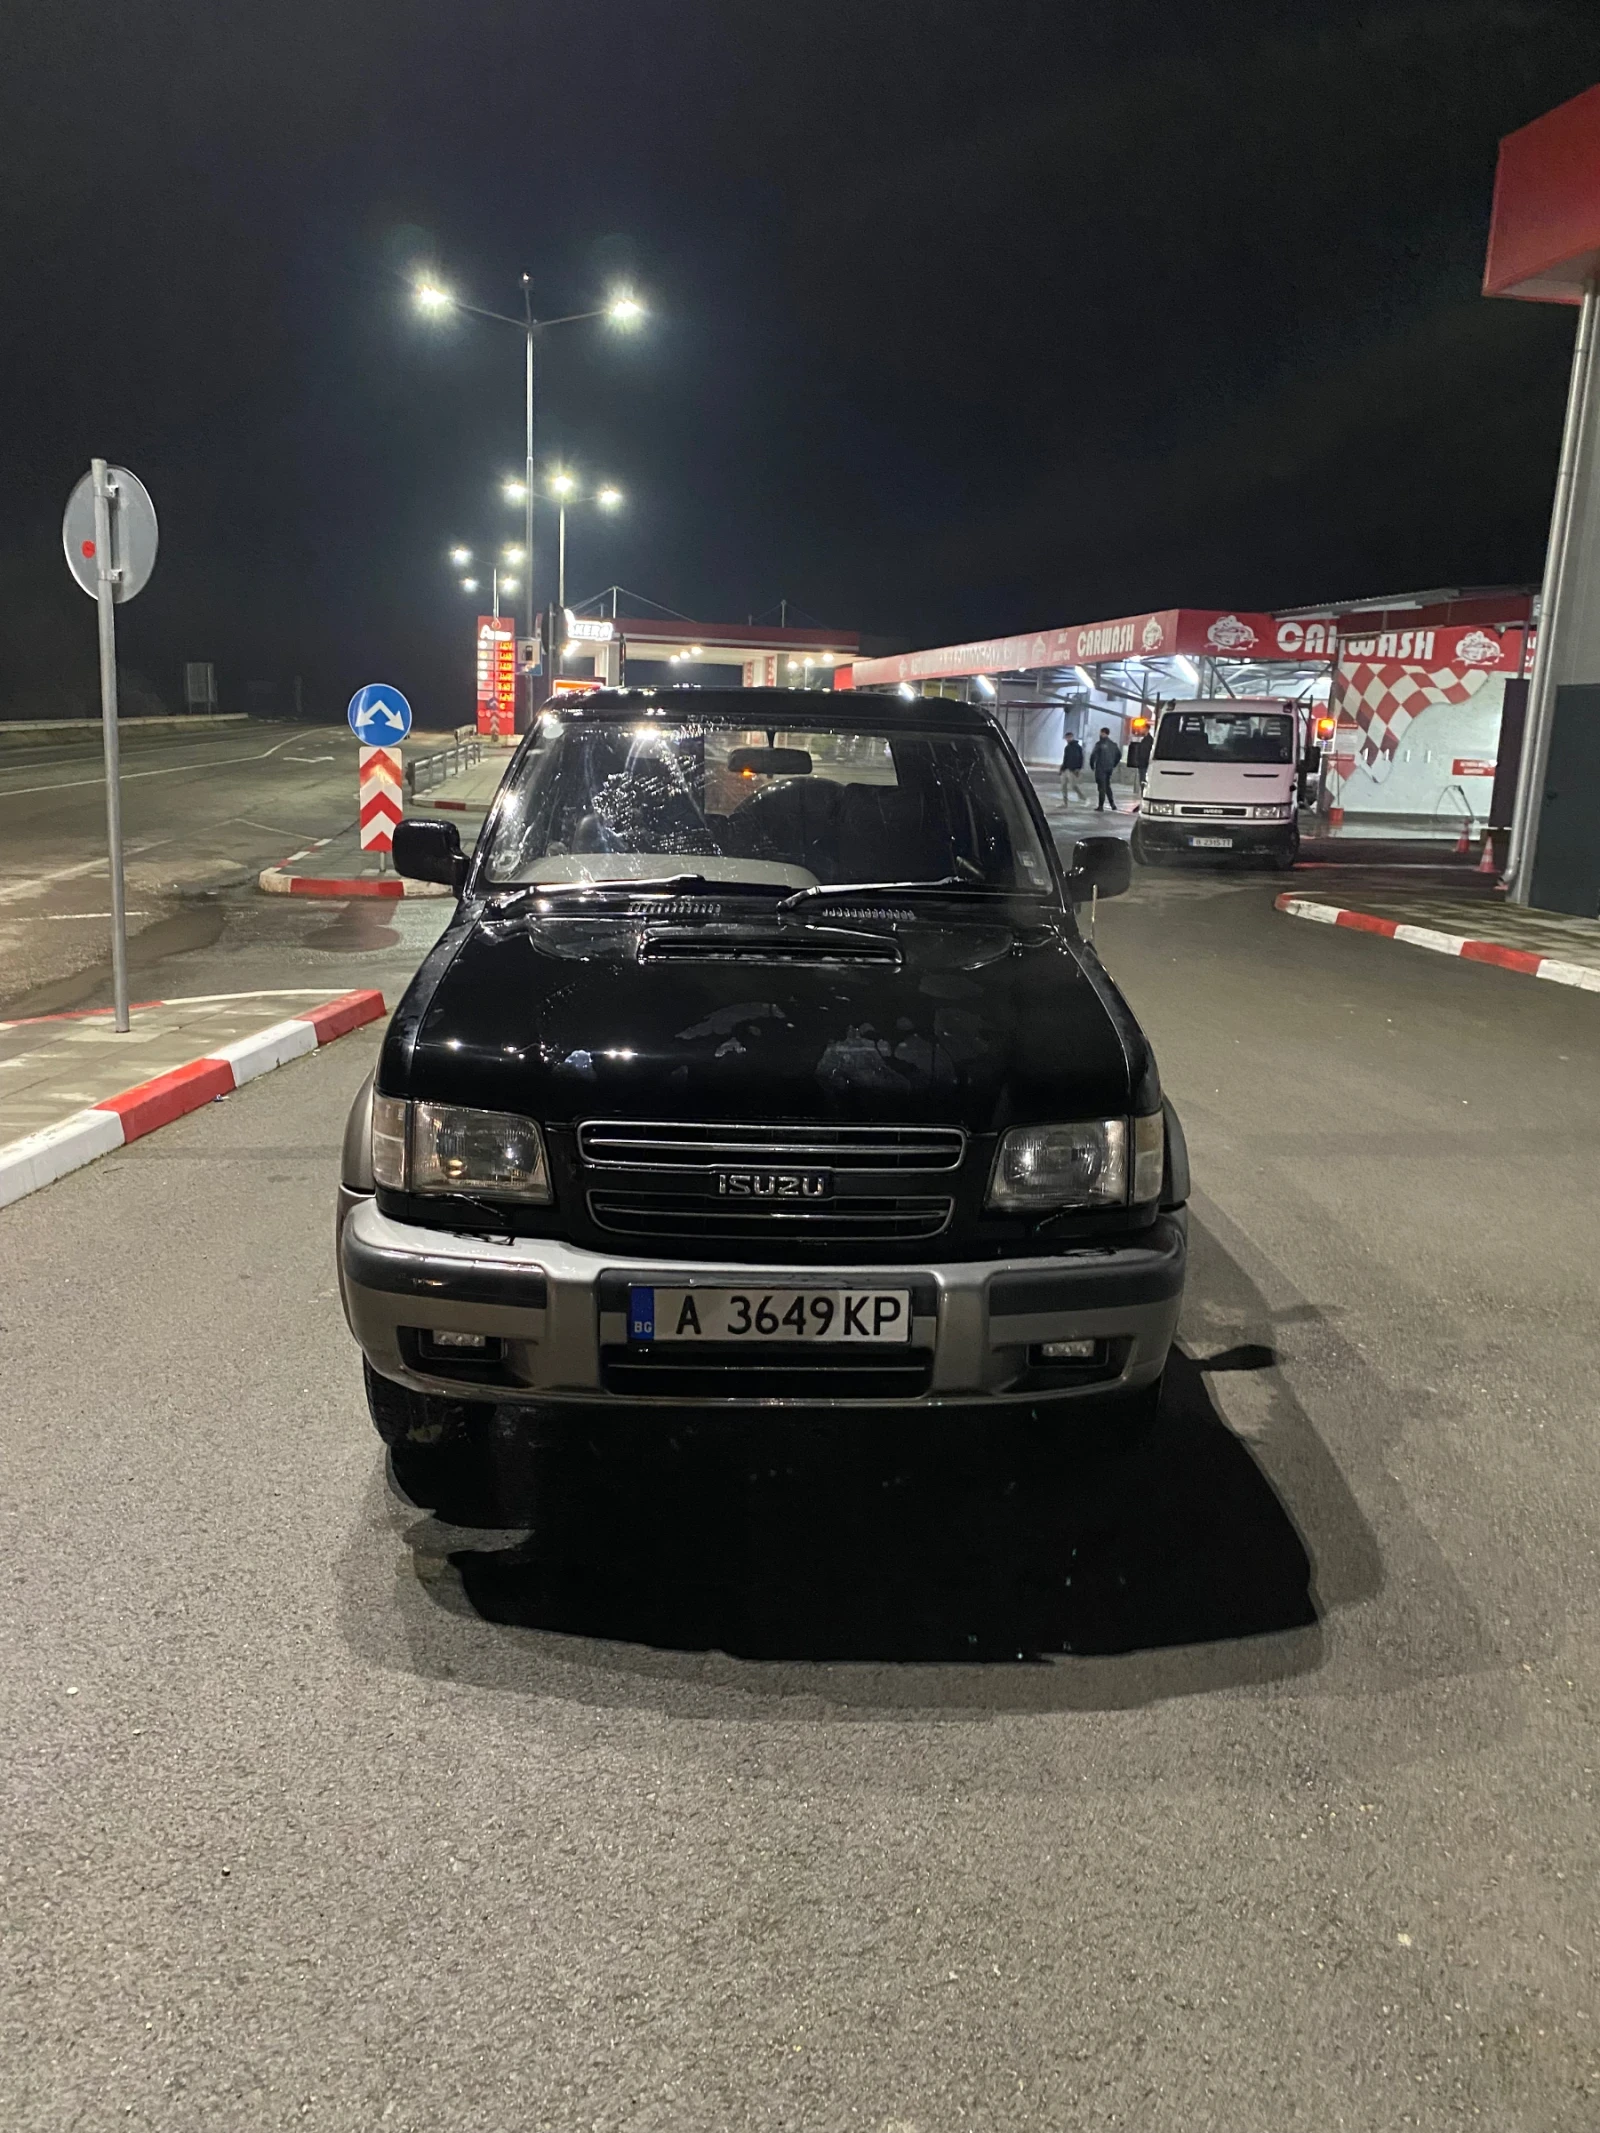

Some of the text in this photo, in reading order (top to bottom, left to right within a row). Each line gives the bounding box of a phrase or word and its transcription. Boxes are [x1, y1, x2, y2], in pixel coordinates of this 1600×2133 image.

[1077, 624, 1134, 656] CARWASH
[719, 1175, 824, 1196] ISUZU
[634, 1322, 652, 1333] BG
[676, 1295, 701, 1335] A
